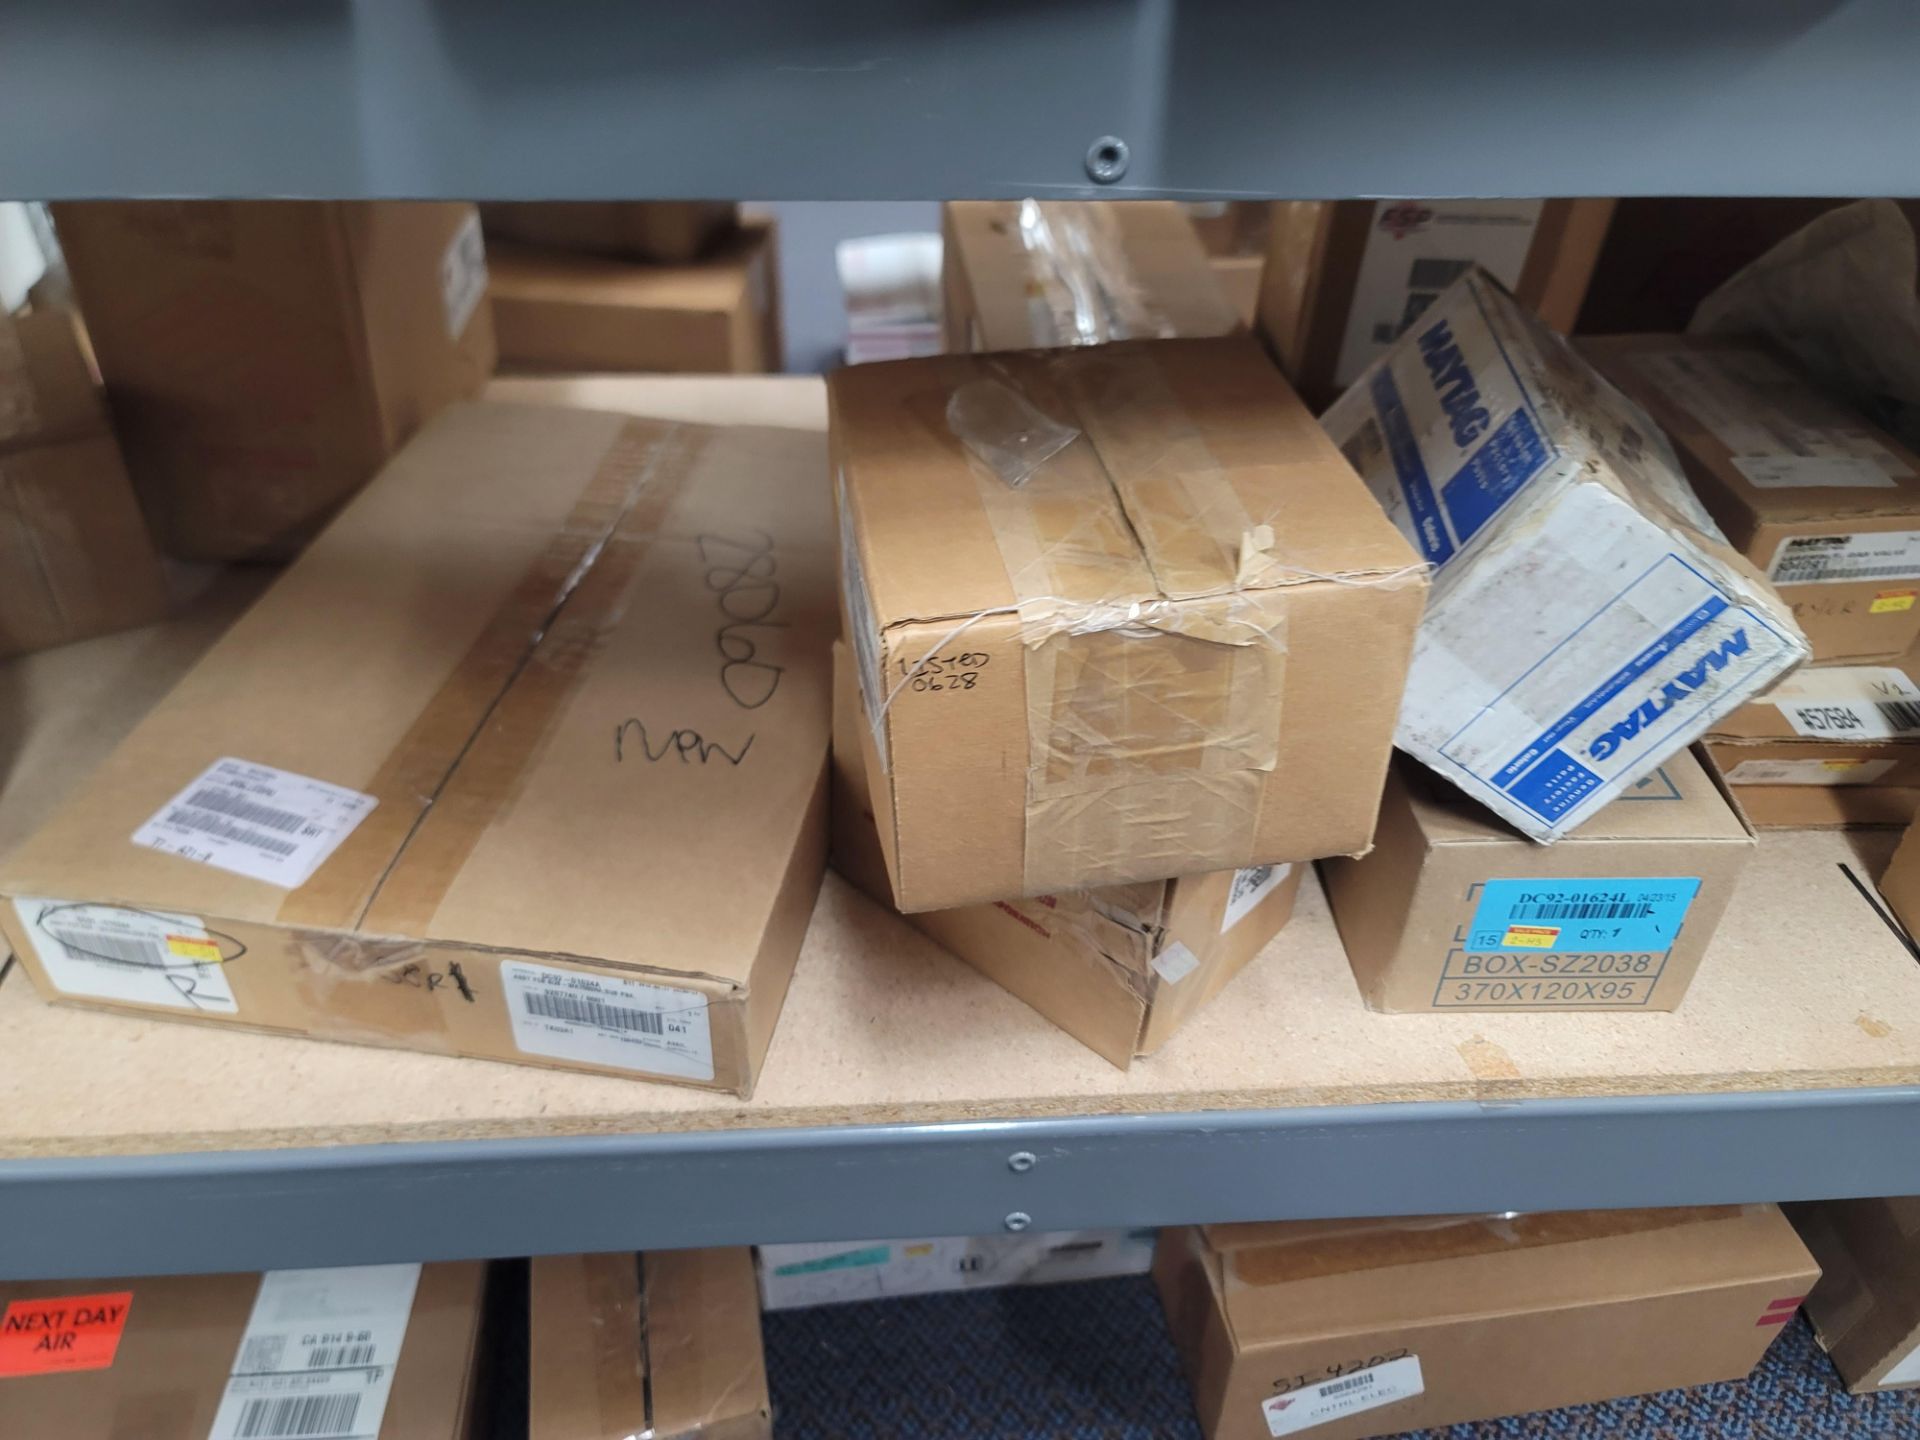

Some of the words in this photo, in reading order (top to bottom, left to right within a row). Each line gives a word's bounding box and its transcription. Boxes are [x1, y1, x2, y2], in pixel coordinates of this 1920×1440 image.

[1417, 319, 1491, 448] MAYTAG
[912, 672, 979, 692] 0628
[1587, 628, 1750, 762] MAYTAG
[1477, 934, 1498, 947] 15
[1463, 954, 1652, 975] BOX-SZ2038
[1454, 981, 1636, 1001] 370X120X95
[5, 1310, 66, 1334] NEXT
[72, 1304, 124, 1327] DAY
[33, 1332, 76, 1353] AIR
